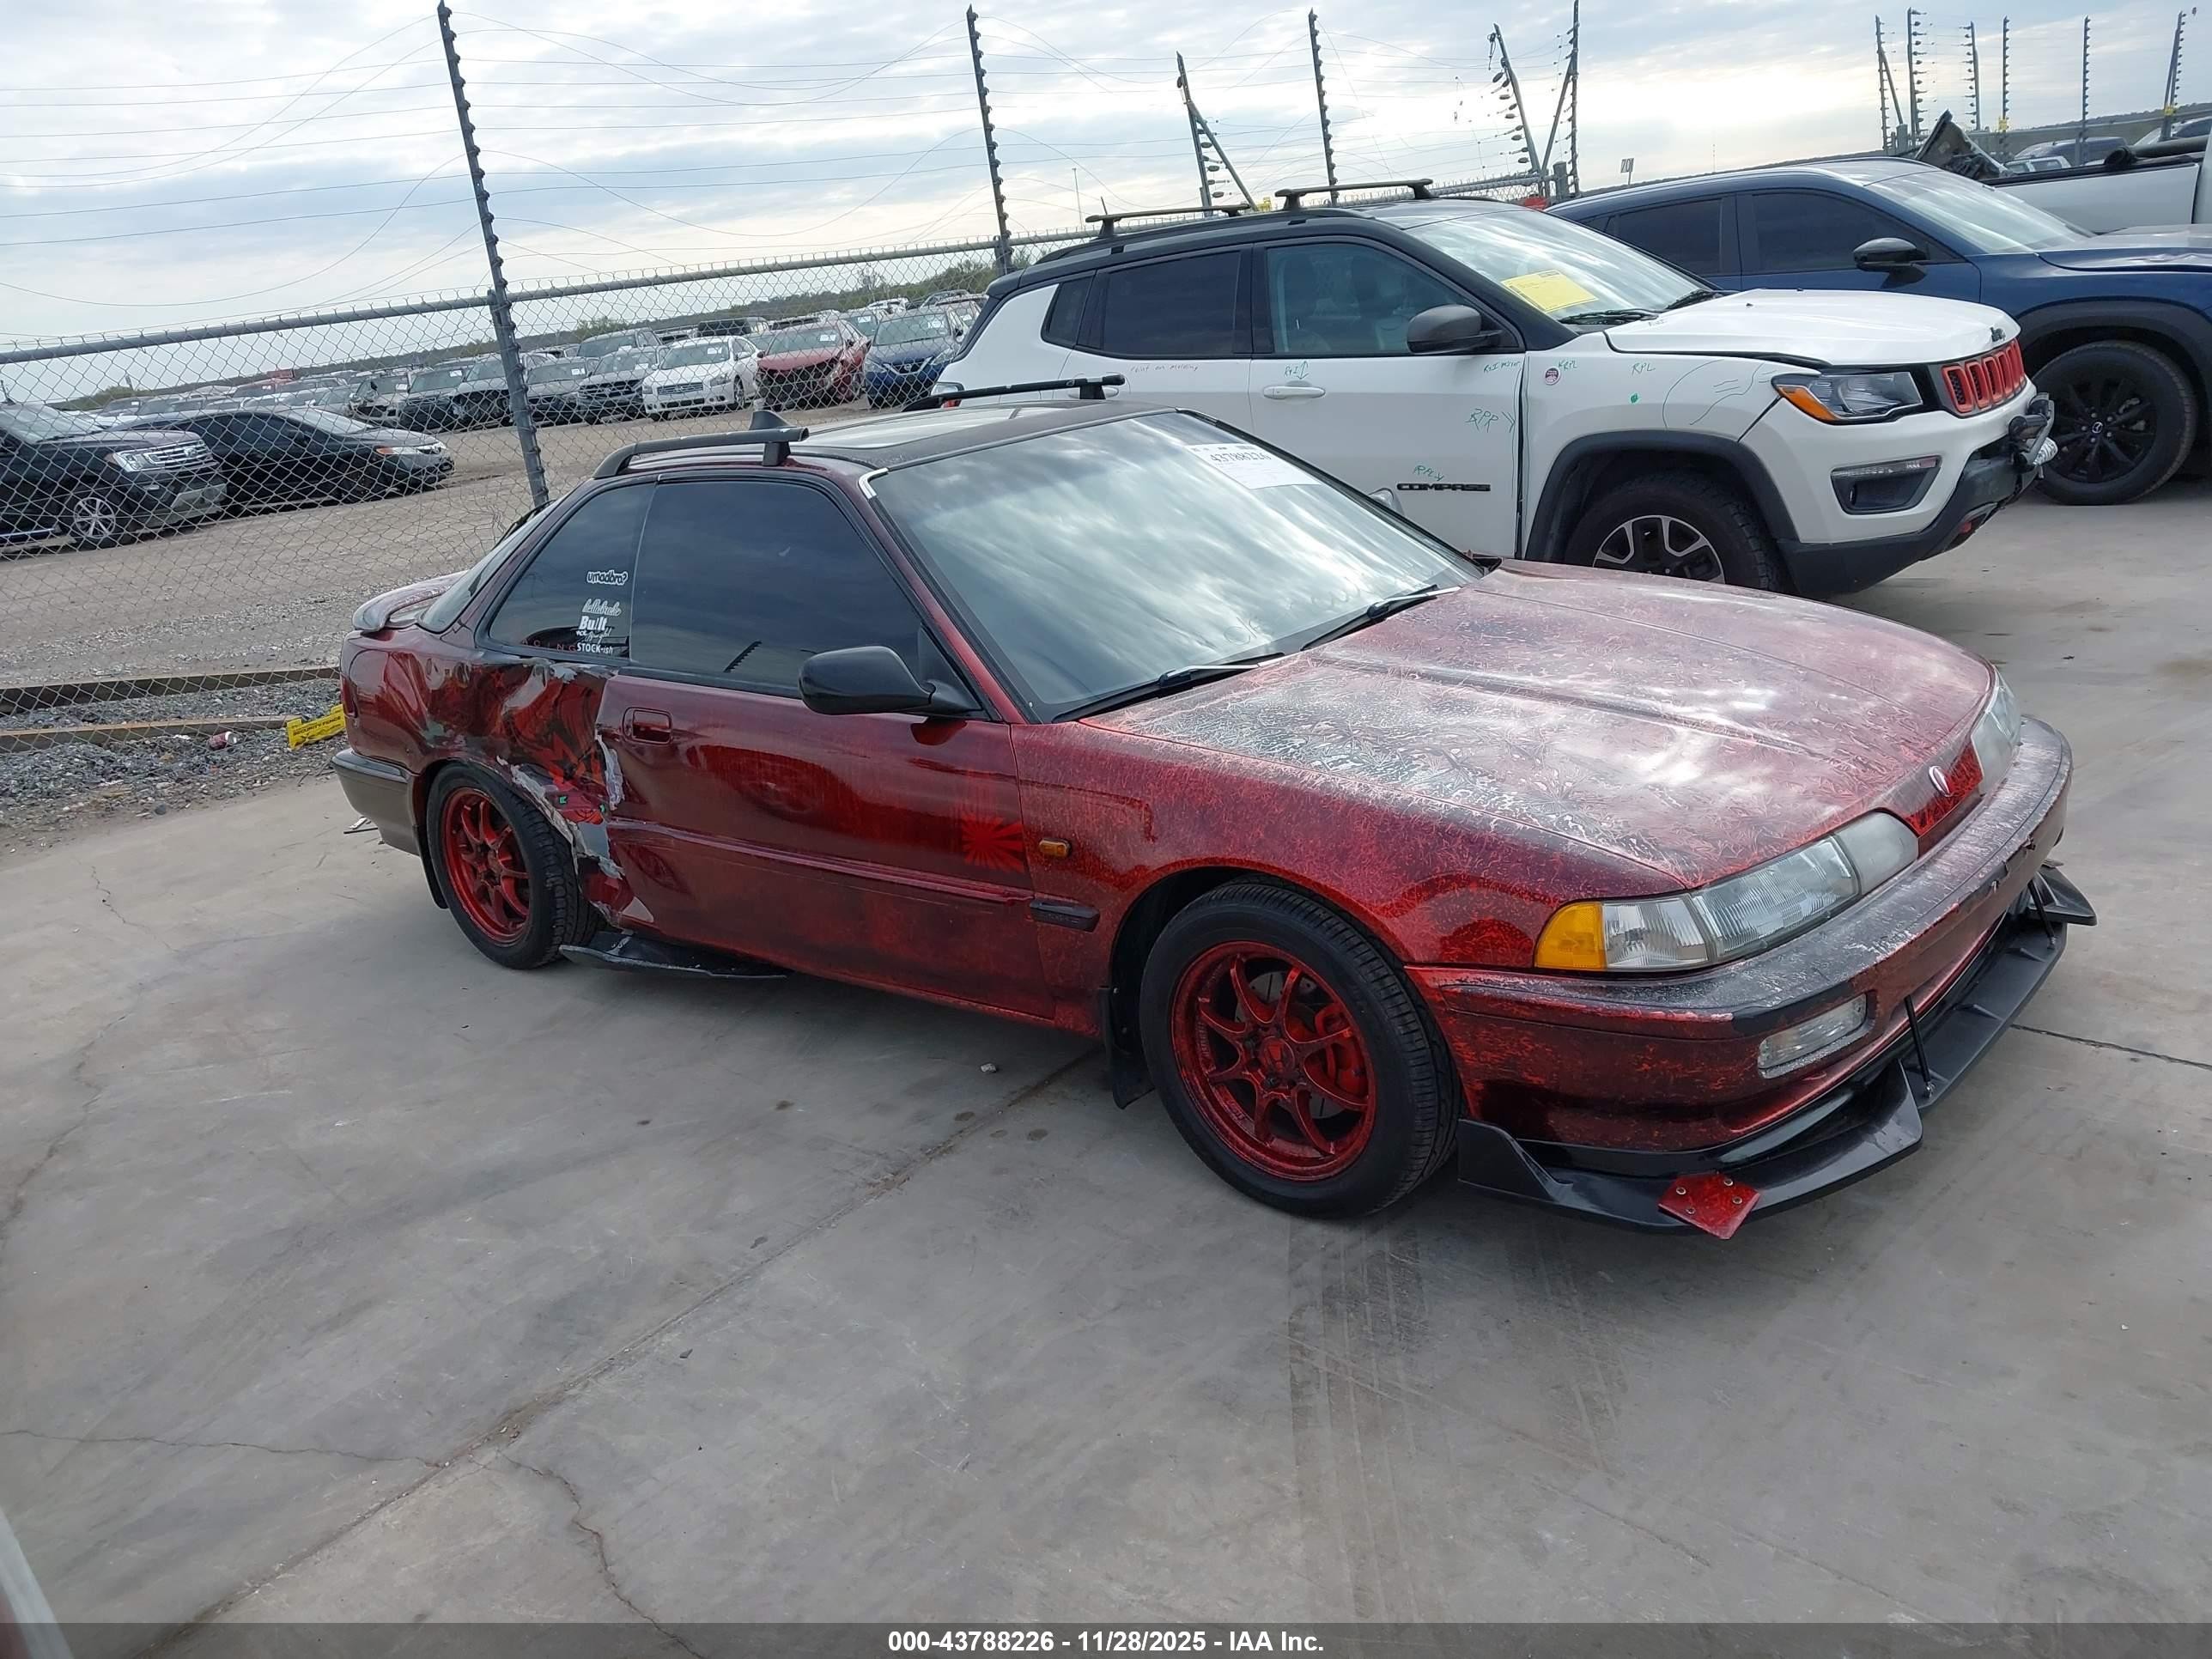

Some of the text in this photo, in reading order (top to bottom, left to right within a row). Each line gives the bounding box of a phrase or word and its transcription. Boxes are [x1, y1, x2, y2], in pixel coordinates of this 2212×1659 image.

[1396, 483, 1491, 492] COMPASS
[579, 616, 607, 630] Built
[576, 642, 613, 653] STOCK-ish
